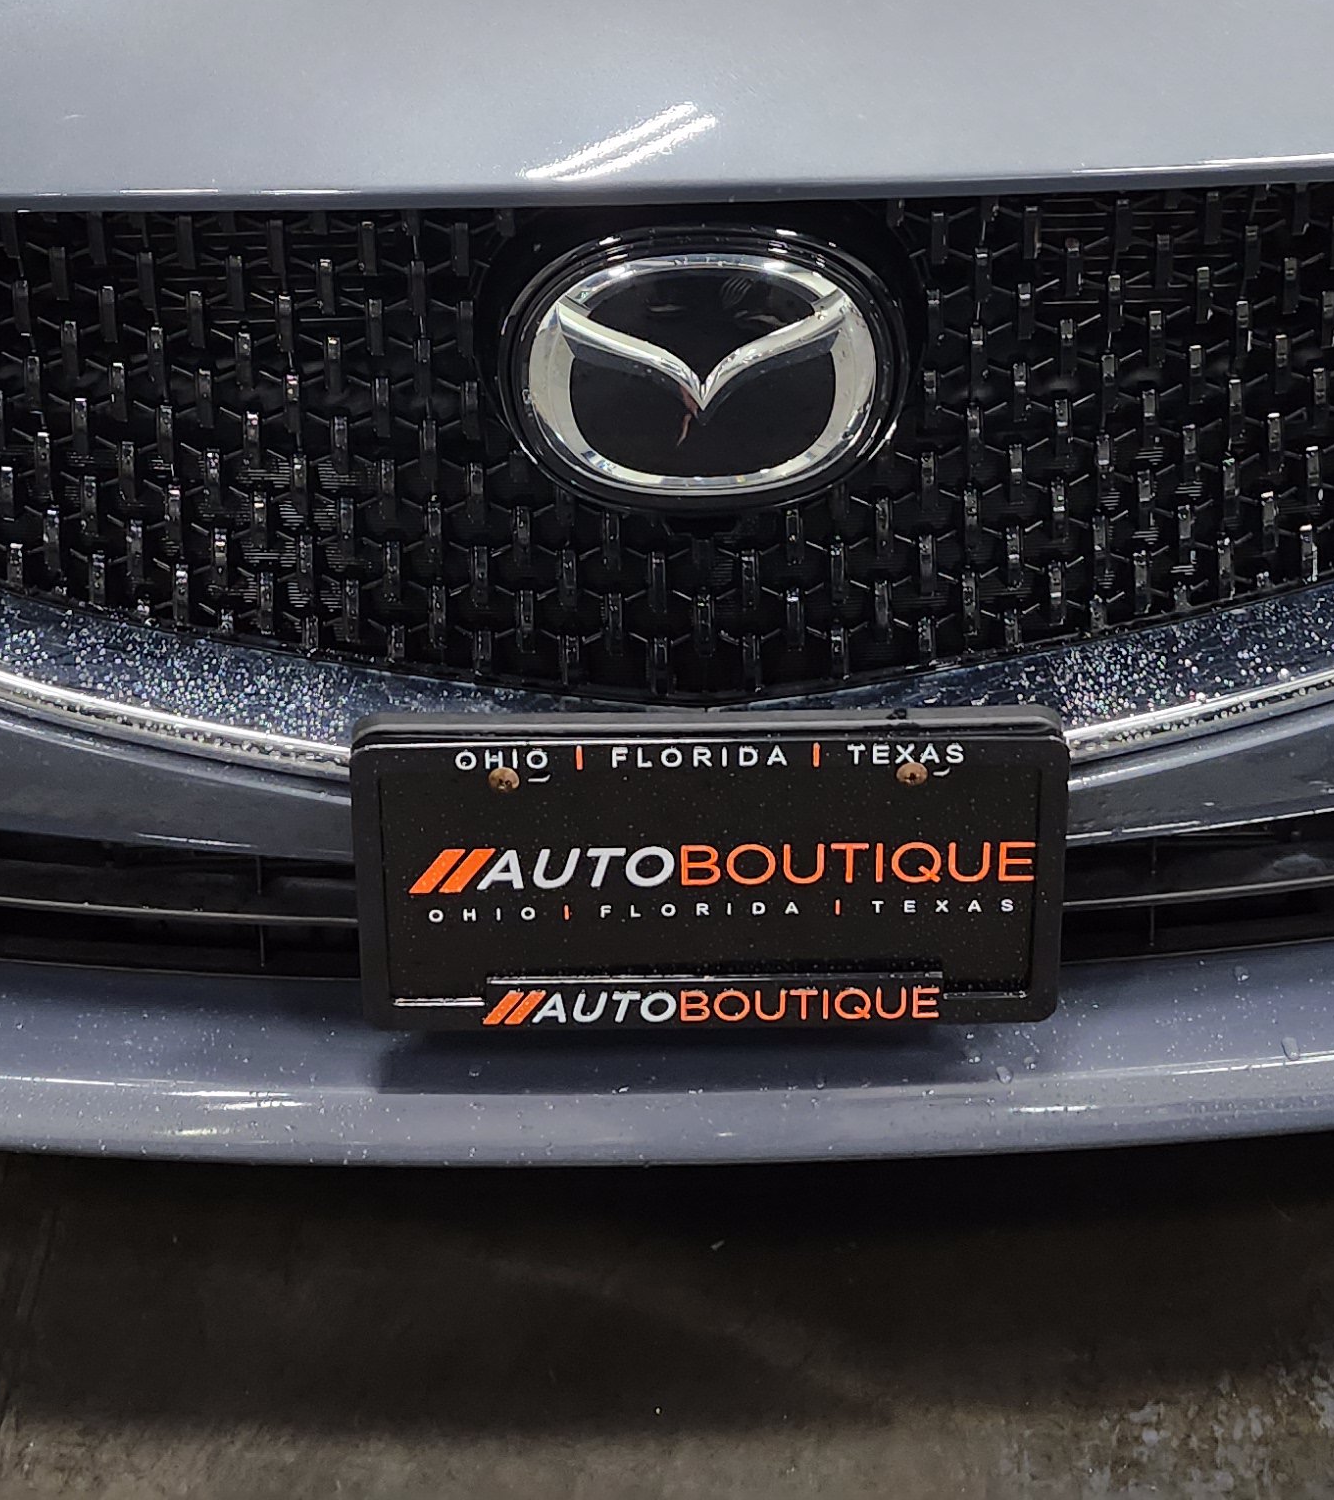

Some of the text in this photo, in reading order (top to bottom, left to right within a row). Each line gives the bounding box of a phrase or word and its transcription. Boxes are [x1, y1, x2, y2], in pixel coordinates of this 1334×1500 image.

[454, 743, 965, 771] OHIO FLORIDA TEXAS
[475, 841, 1037, 891] AUTOBOUTIQUE
[428, 898, 1015, 924] OHIO FLORIDA TEXAS
[531, 986, 941, 1024] AUTOBOUTIQUE
